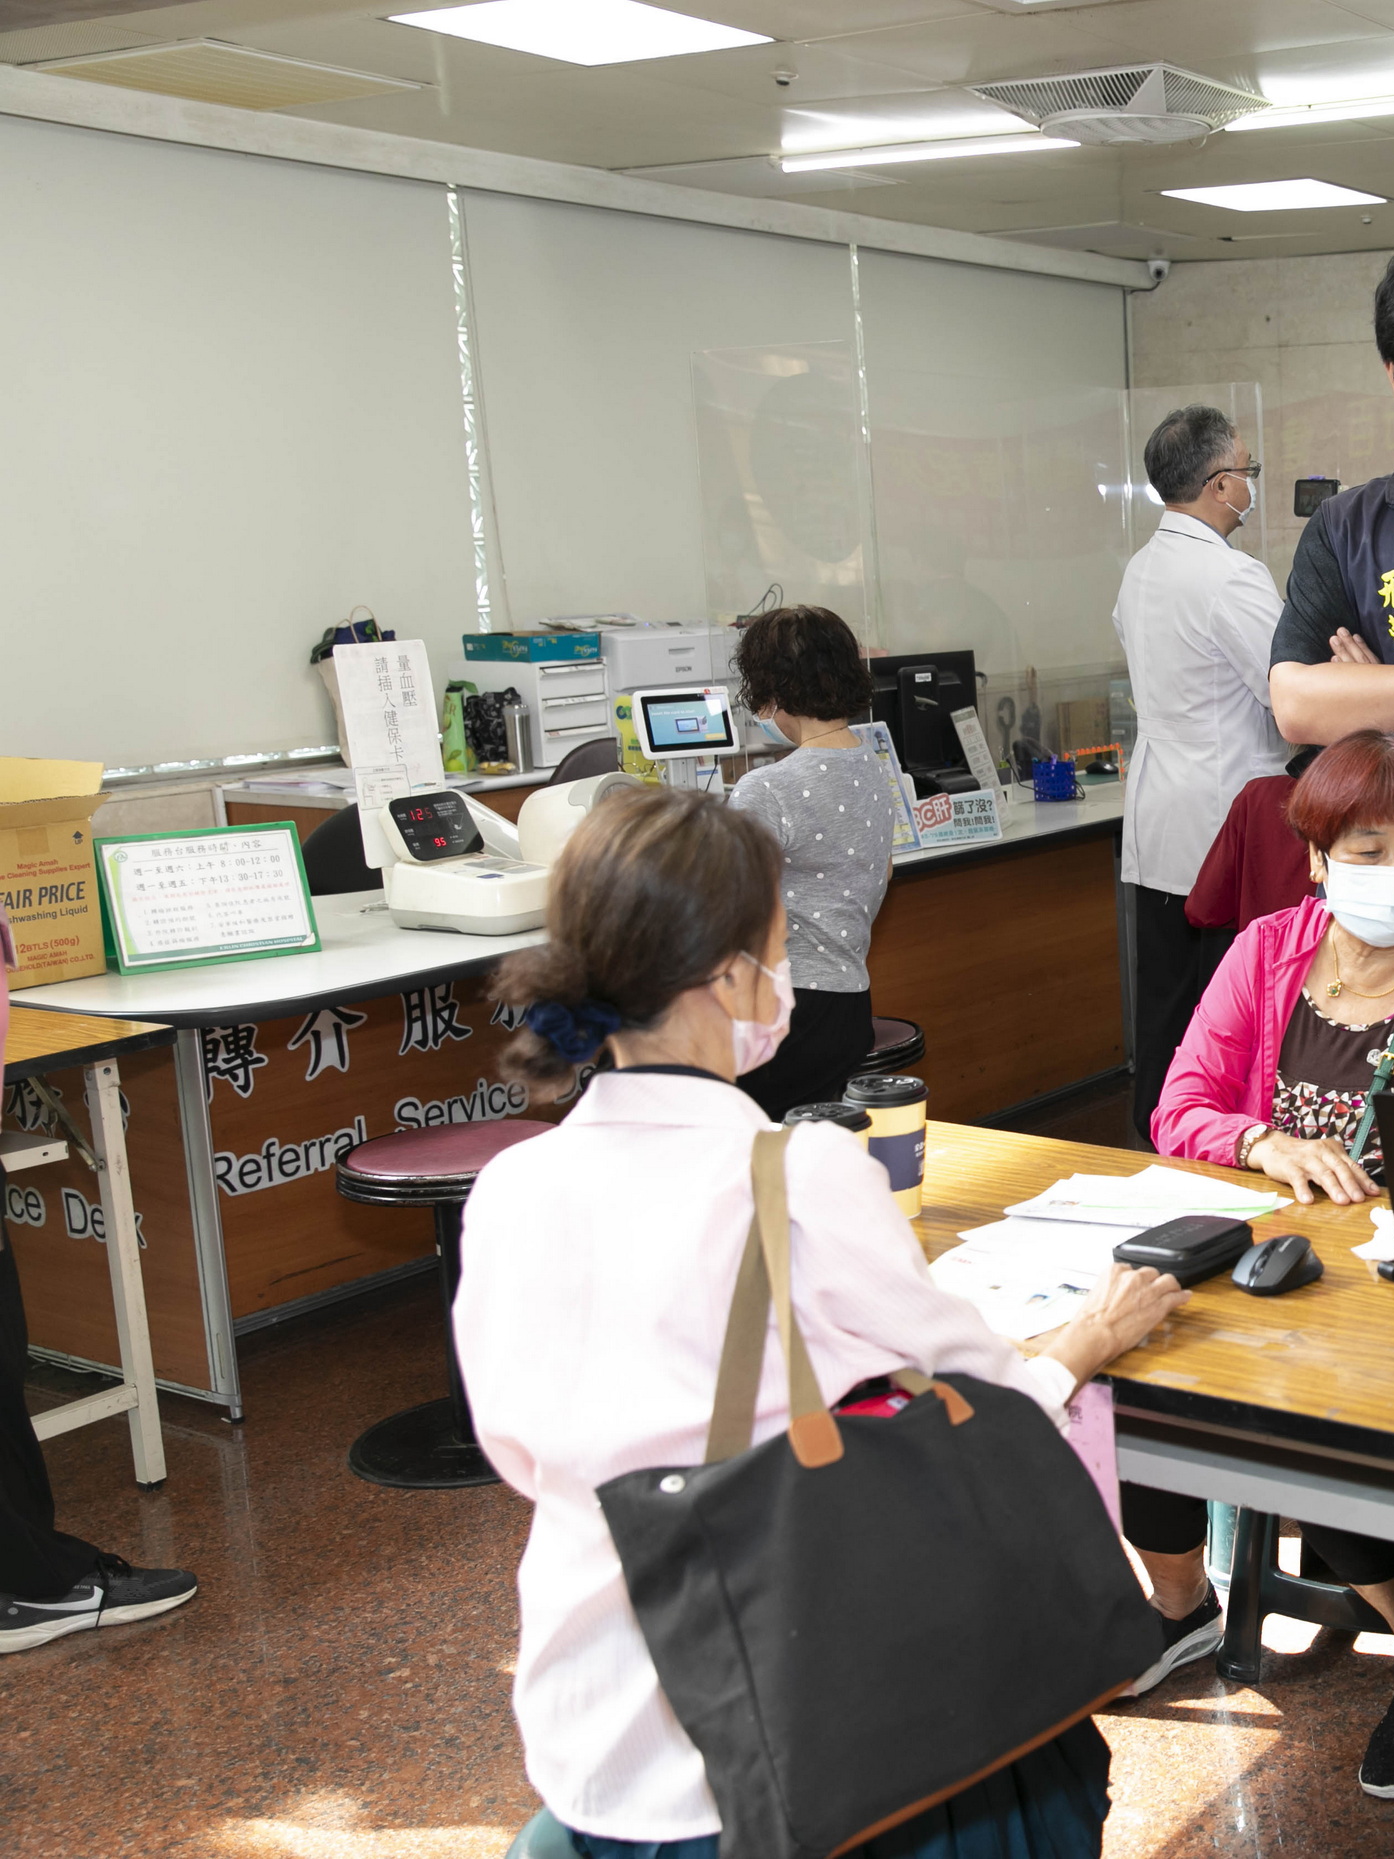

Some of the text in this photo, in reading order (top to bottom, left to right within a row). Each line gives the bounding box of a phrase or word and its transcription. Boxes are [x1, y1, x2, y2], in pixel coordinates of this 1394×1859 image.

[397, 654, 417, 708] 量血壓
[374, 656, 404, 762] 請插入健保卡
[433, 837, 447, 847] 95
[7, 869, 37, 880] Cleaning
[38, 866, 68, 876] Supplies
[69, 862, 91, 872] Expert
[17, 862, 37, 870] Magic
[38, 881, 86, 906] PRICE
[8, 905, 88, 924] shwashing Liquid
[240, 940, 273, 948] CHRISTIAN
[274, 936, 303, 944] HOSPITAL
[27, 950, 68, 962] MAGIC AMAH
[214, 1118, 364, 1194] Referral
[396, 1081, 527, 1133] Service
